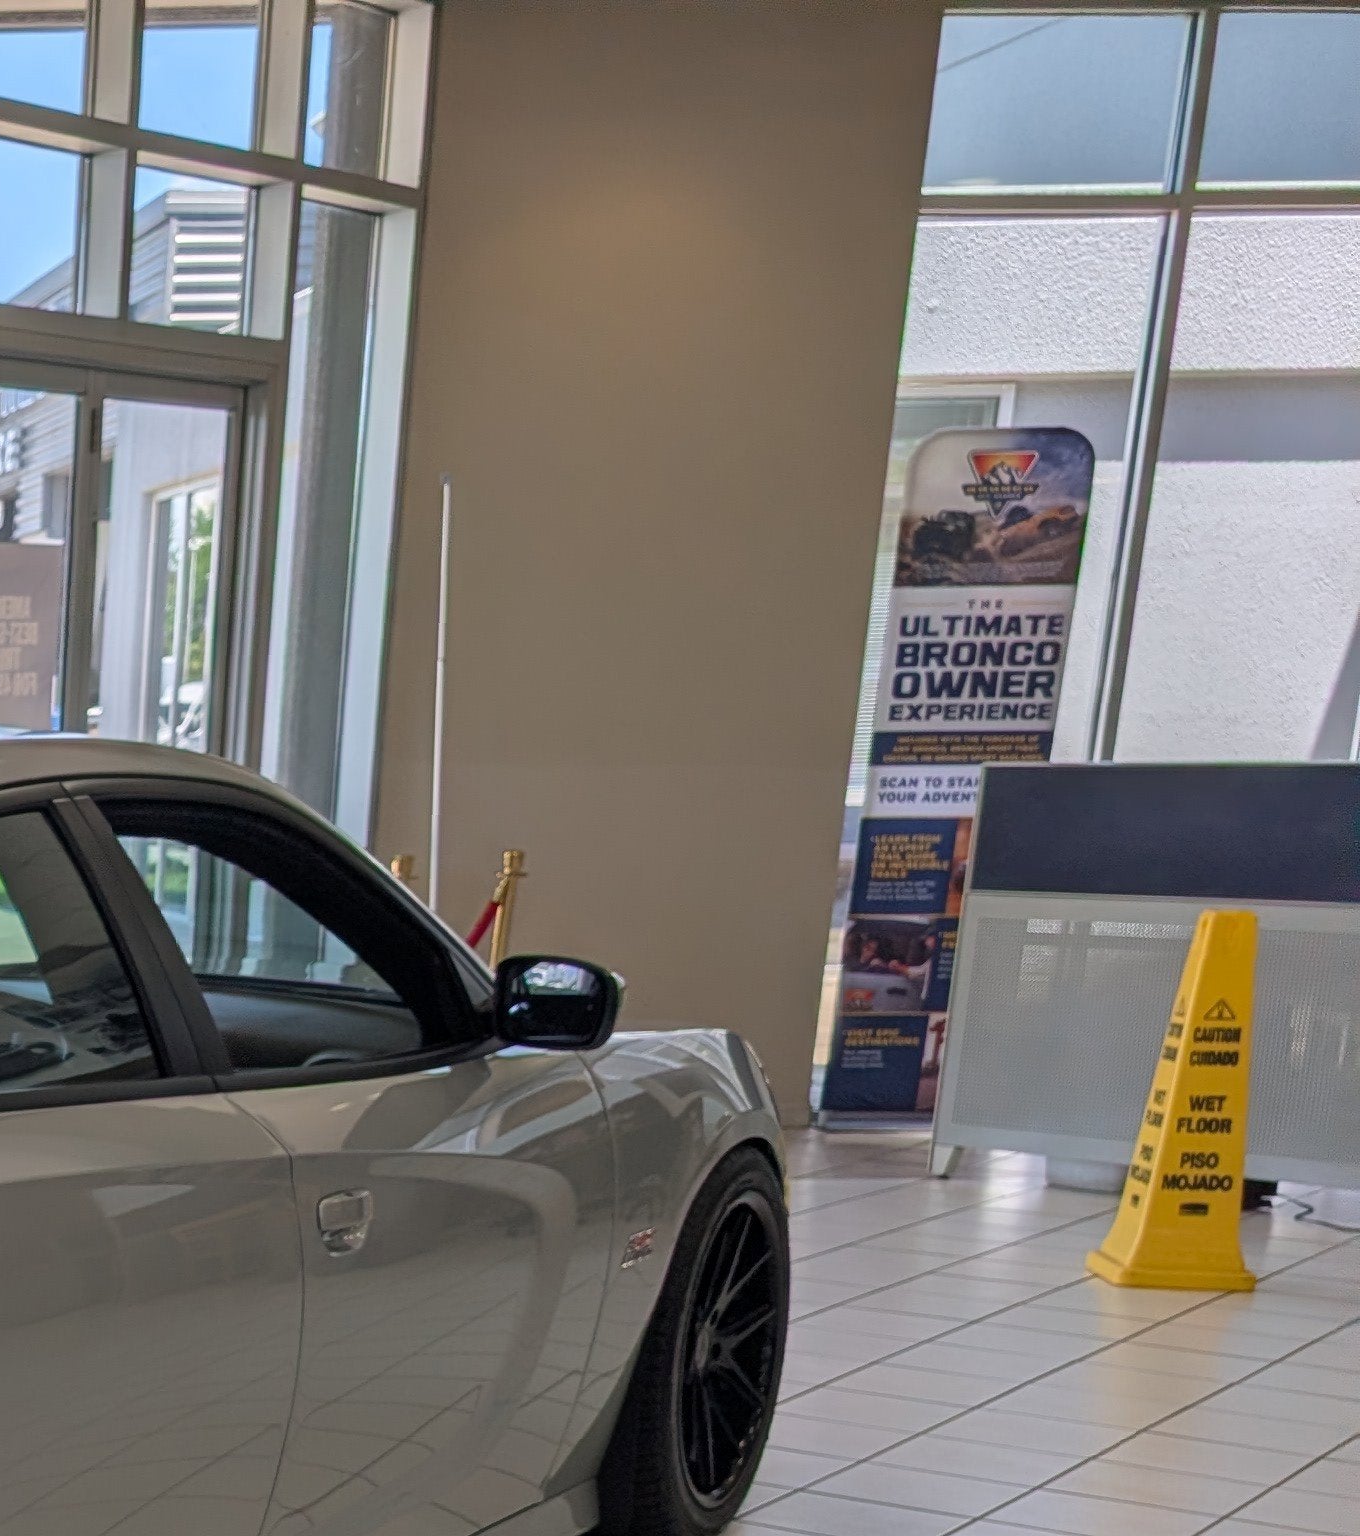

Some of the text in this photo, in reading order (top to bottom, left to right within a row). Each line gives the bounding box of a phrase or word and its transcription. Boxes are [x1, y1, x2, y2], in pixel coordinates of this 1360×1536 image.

[968, 599, 1004, 610] THE
[900, 614, 1065, 637] ULTIMATE
[895, 641, 1061, 668] BRONCO
[892, 670, 1056, 699] OWNER
[888, 702, 1053, 722] EXPERIENCE
[880, 776, 918, 788] SCAN
[925, 776, 942, 788] TO
[878, 791, 917, 803] YOUR
[1193, 1026, 1242, 1044] CAUTION
[1190, 1047, 1239, 1066] CUIDADO
[1189, 1094, 1227, 1112] WET
[1176, 1117, 1232, 1134] FLOOR
[1180, 1152, 1219, 1170] PISO
[1162, 1174, 1233, 1192] MOJADO
